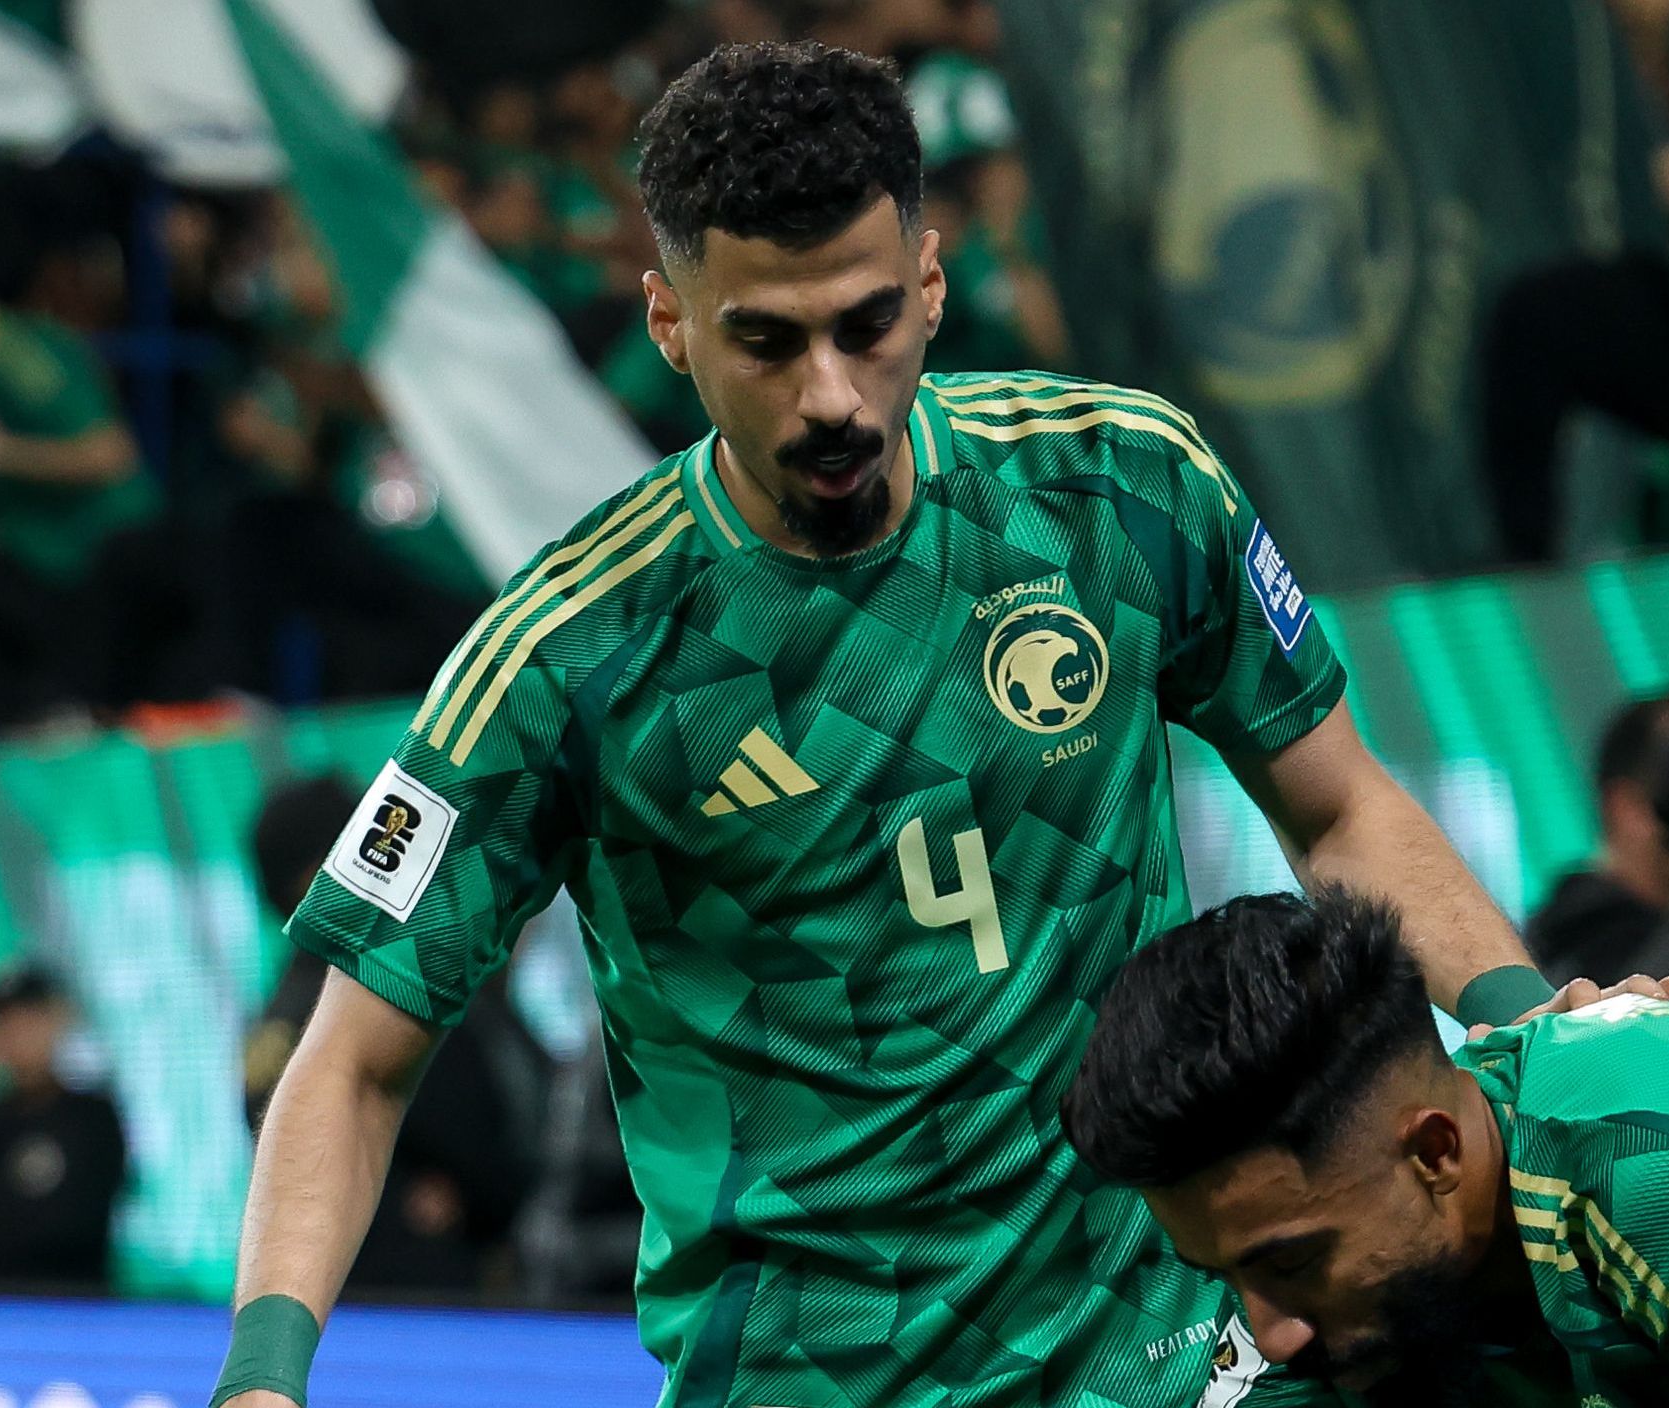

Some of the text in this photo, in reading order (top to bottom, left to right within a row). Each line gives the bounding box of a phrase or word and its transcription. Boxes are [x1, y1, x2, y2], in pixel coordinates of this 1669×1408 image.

[1055, 669, 1089, 690] SAFF
[1041, 731, 1098, 768] SAUDI
[366, 848, 388, 866] FIFA
[897, 816, 1009, 974] 4
